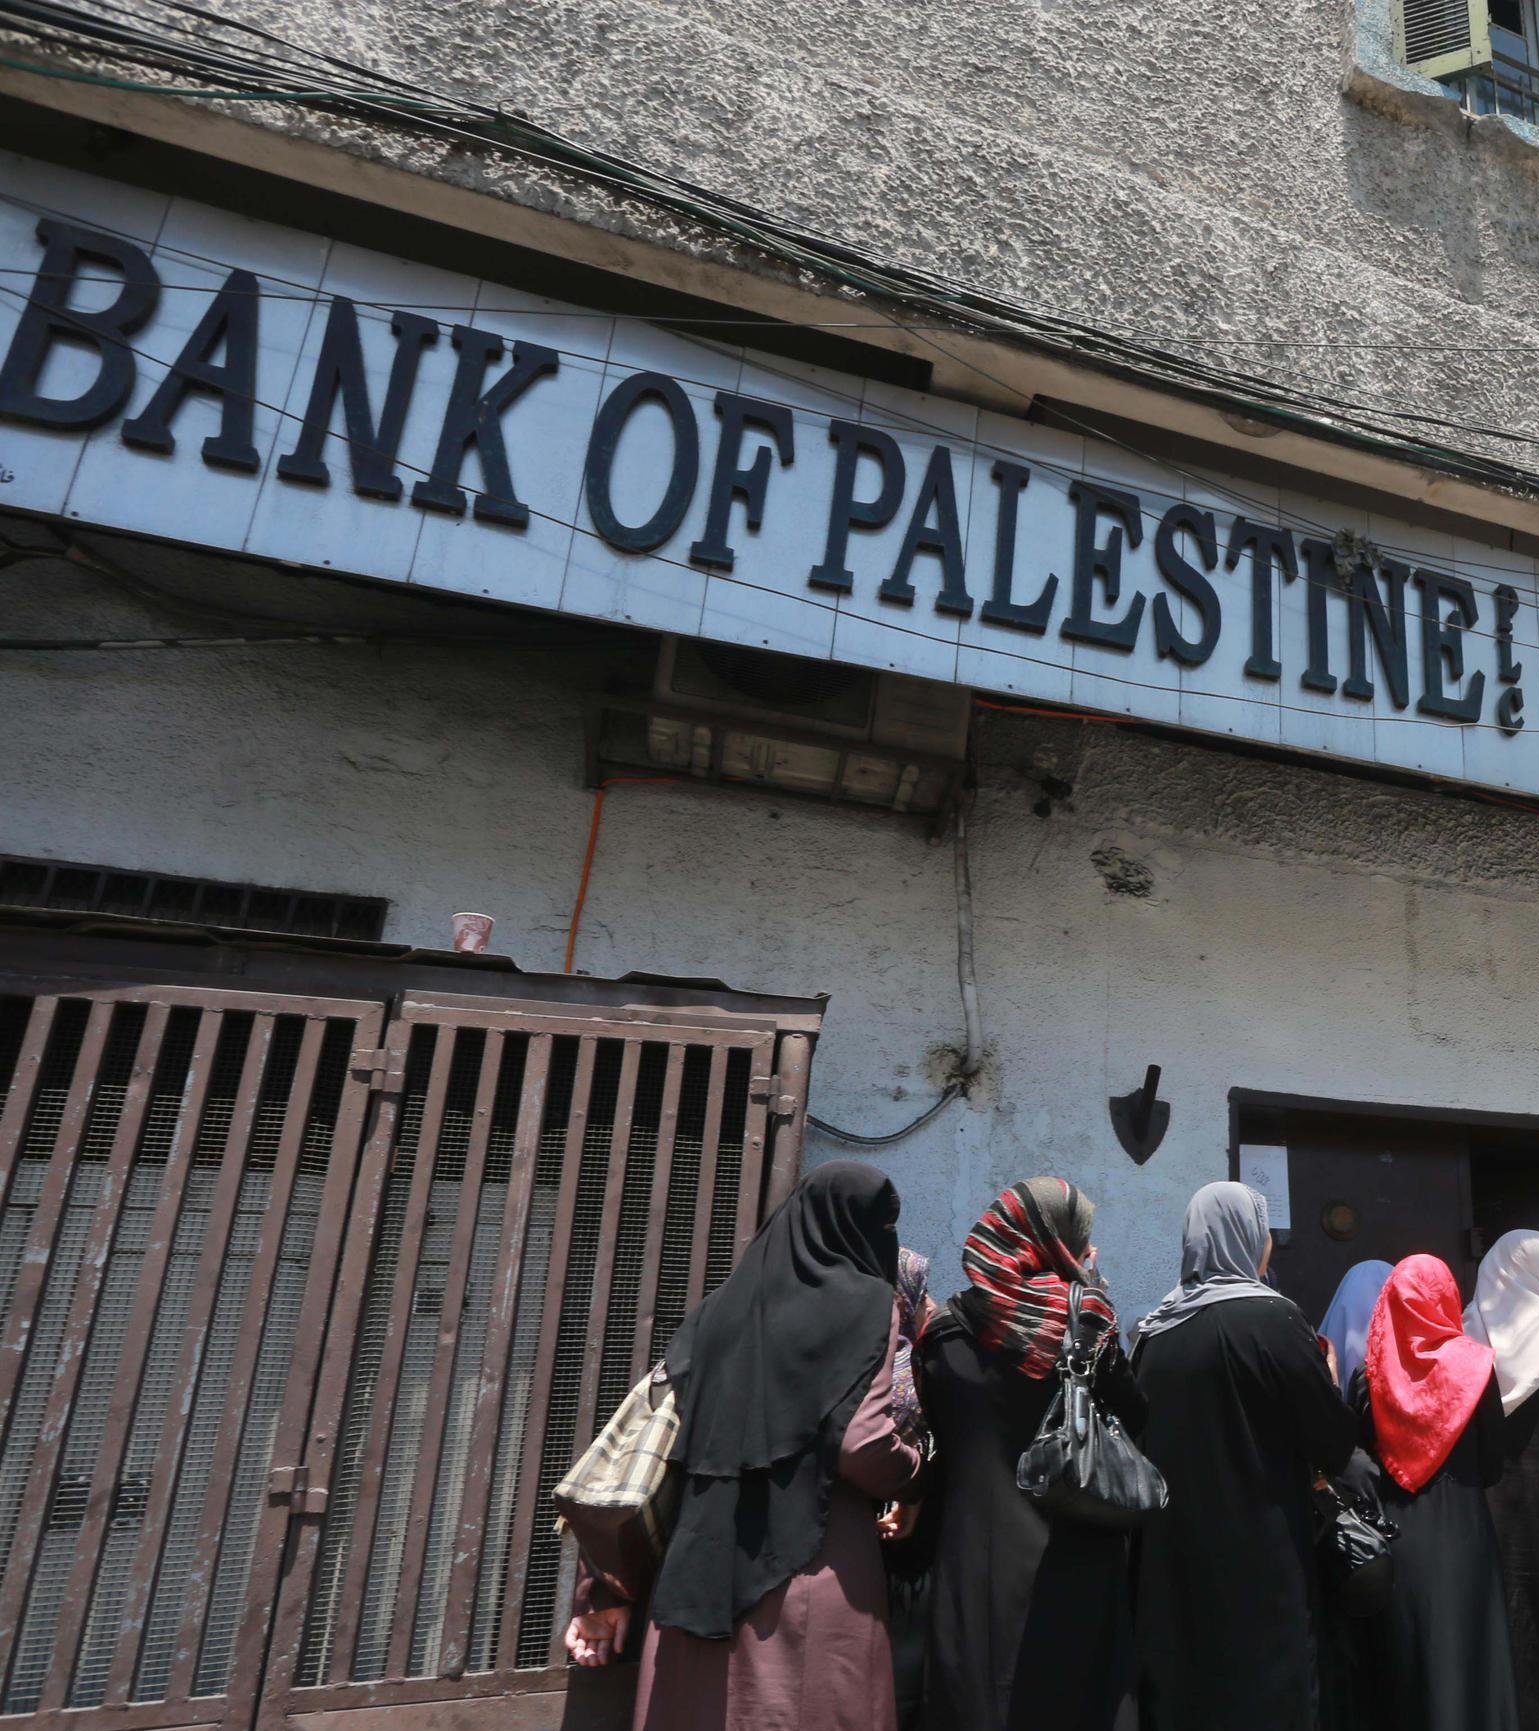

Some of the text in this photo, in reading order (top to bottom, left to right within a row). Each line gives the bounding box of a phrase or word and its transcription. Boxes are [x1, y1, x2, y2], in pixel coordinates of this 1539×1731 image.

[0, 217, 1486, 724] BANK OF PALESTINE
